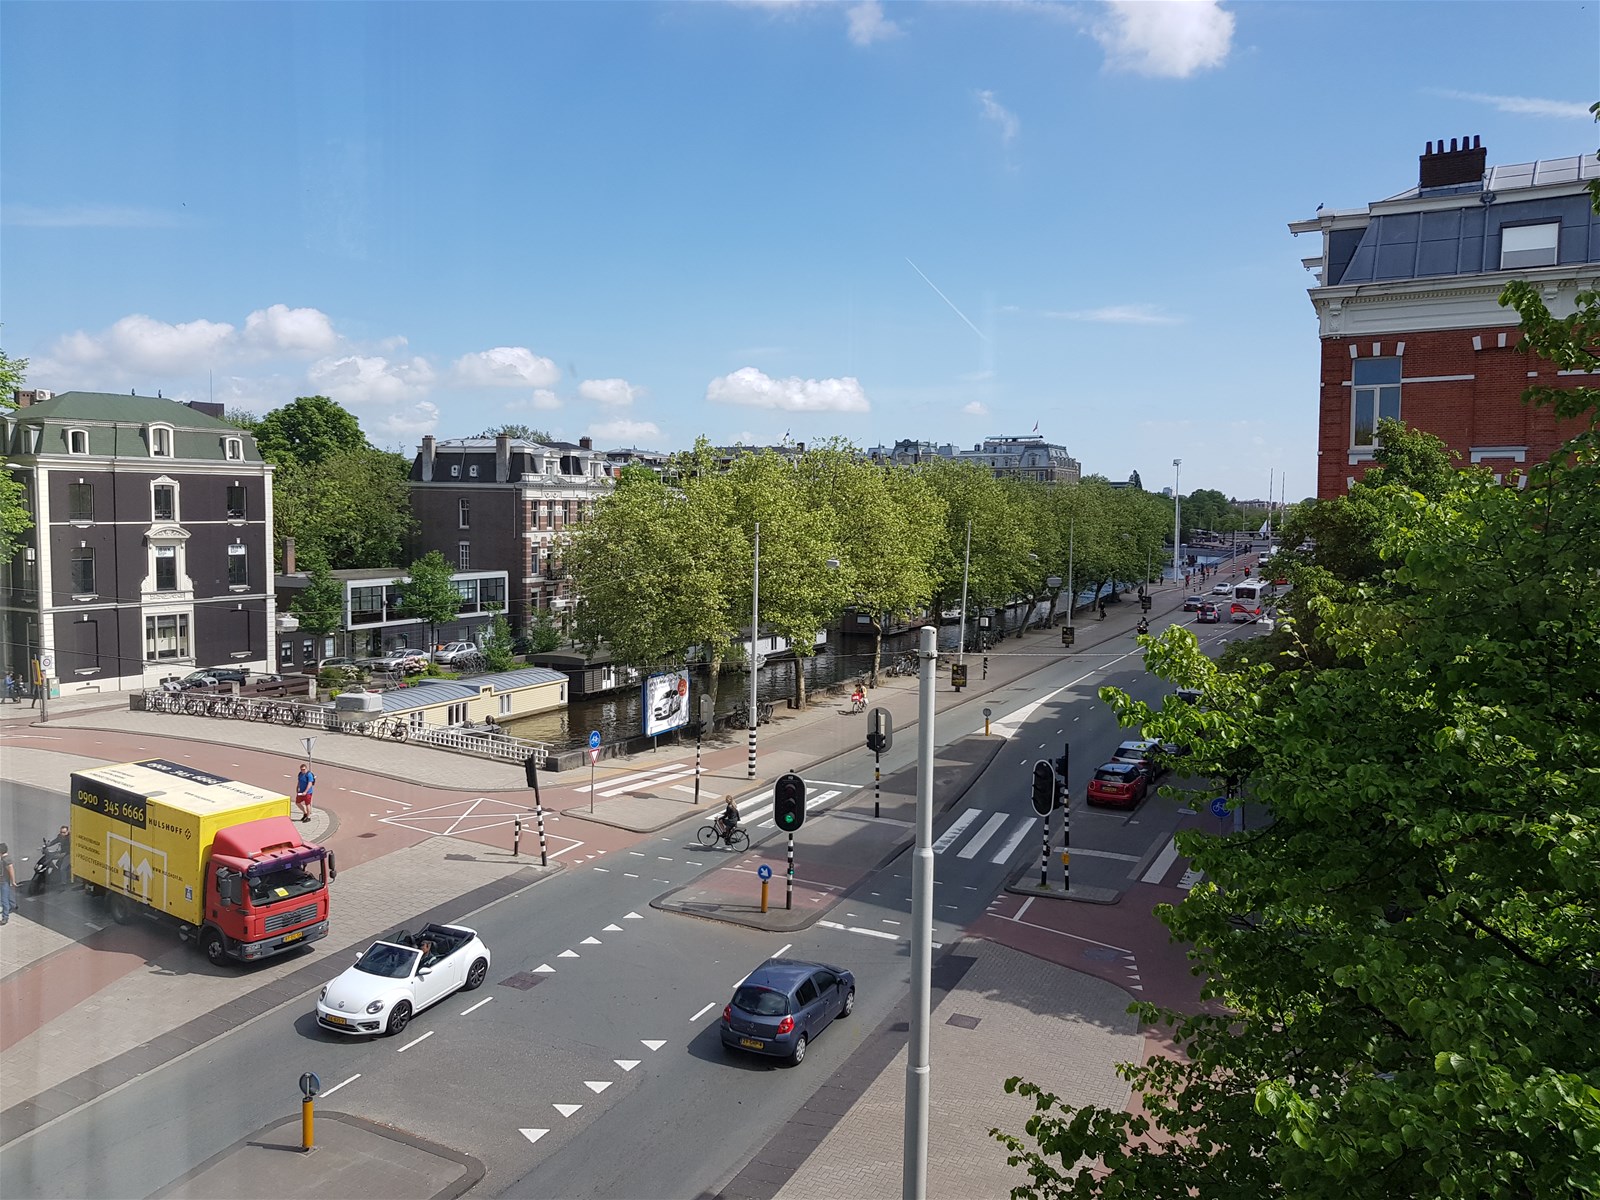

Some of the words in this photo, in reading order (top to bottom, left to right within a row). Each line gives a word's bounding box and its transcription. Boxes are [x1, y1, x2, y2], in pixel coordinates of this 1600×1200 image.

[78, 790, 98, 805] 0900
[103, 799, 119, 815] 345
[122, 803, 144, 821] 6666
[148, 818, 182, 835] HULSHOFF
